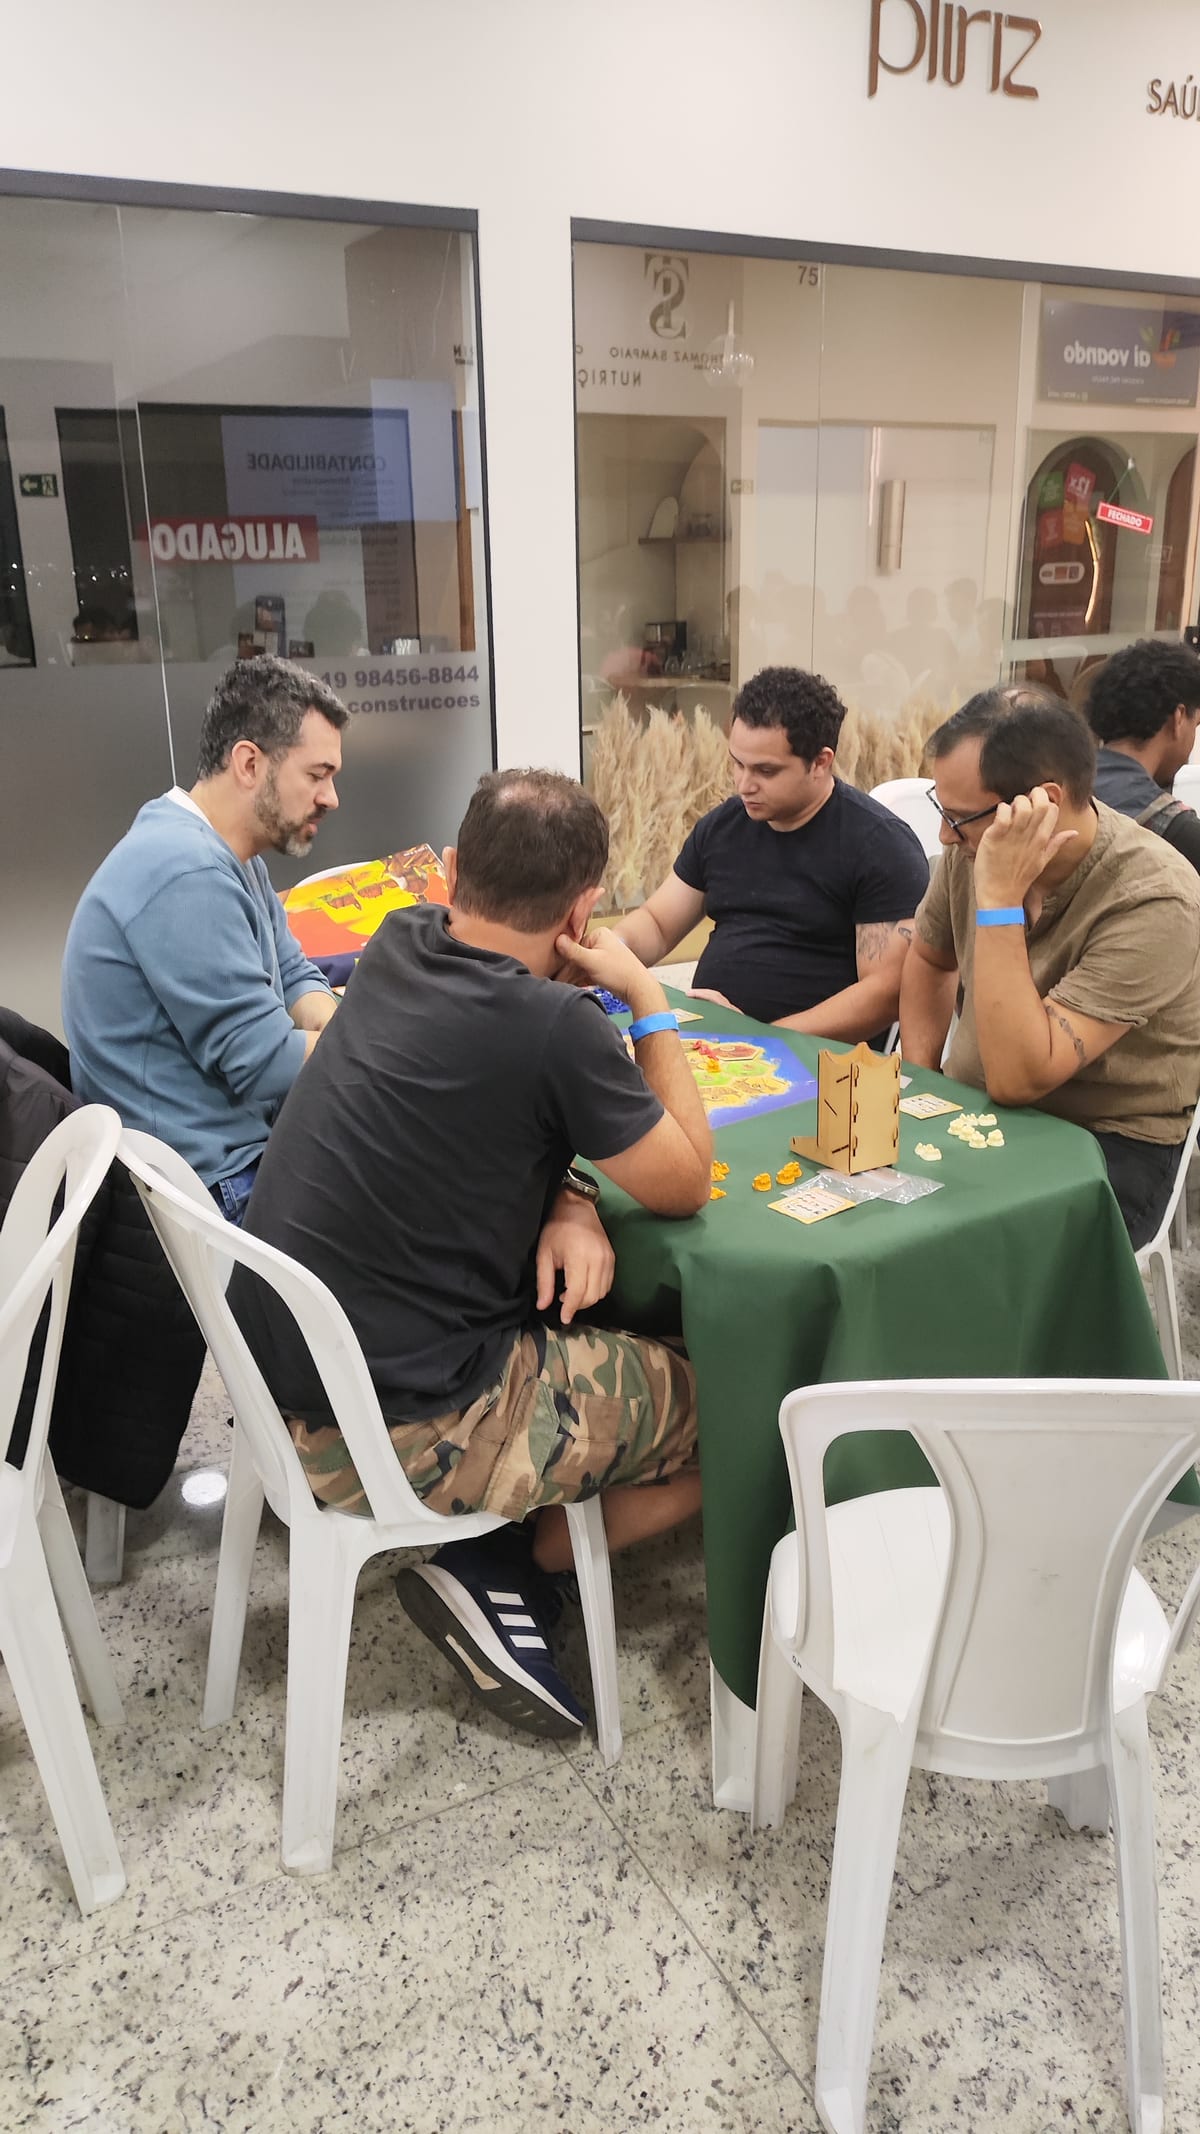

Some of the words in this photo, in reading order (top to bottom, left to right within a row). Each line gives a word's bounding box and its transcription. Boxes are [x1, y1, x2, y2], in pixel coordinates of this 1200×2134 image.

[1146, 74, 1200, 121] SAÚ
[797, 265, 819, 287] 75
[1107, 508, 1143, 528] FECHADO
[355, 665, 480, 688] 98456-8844
